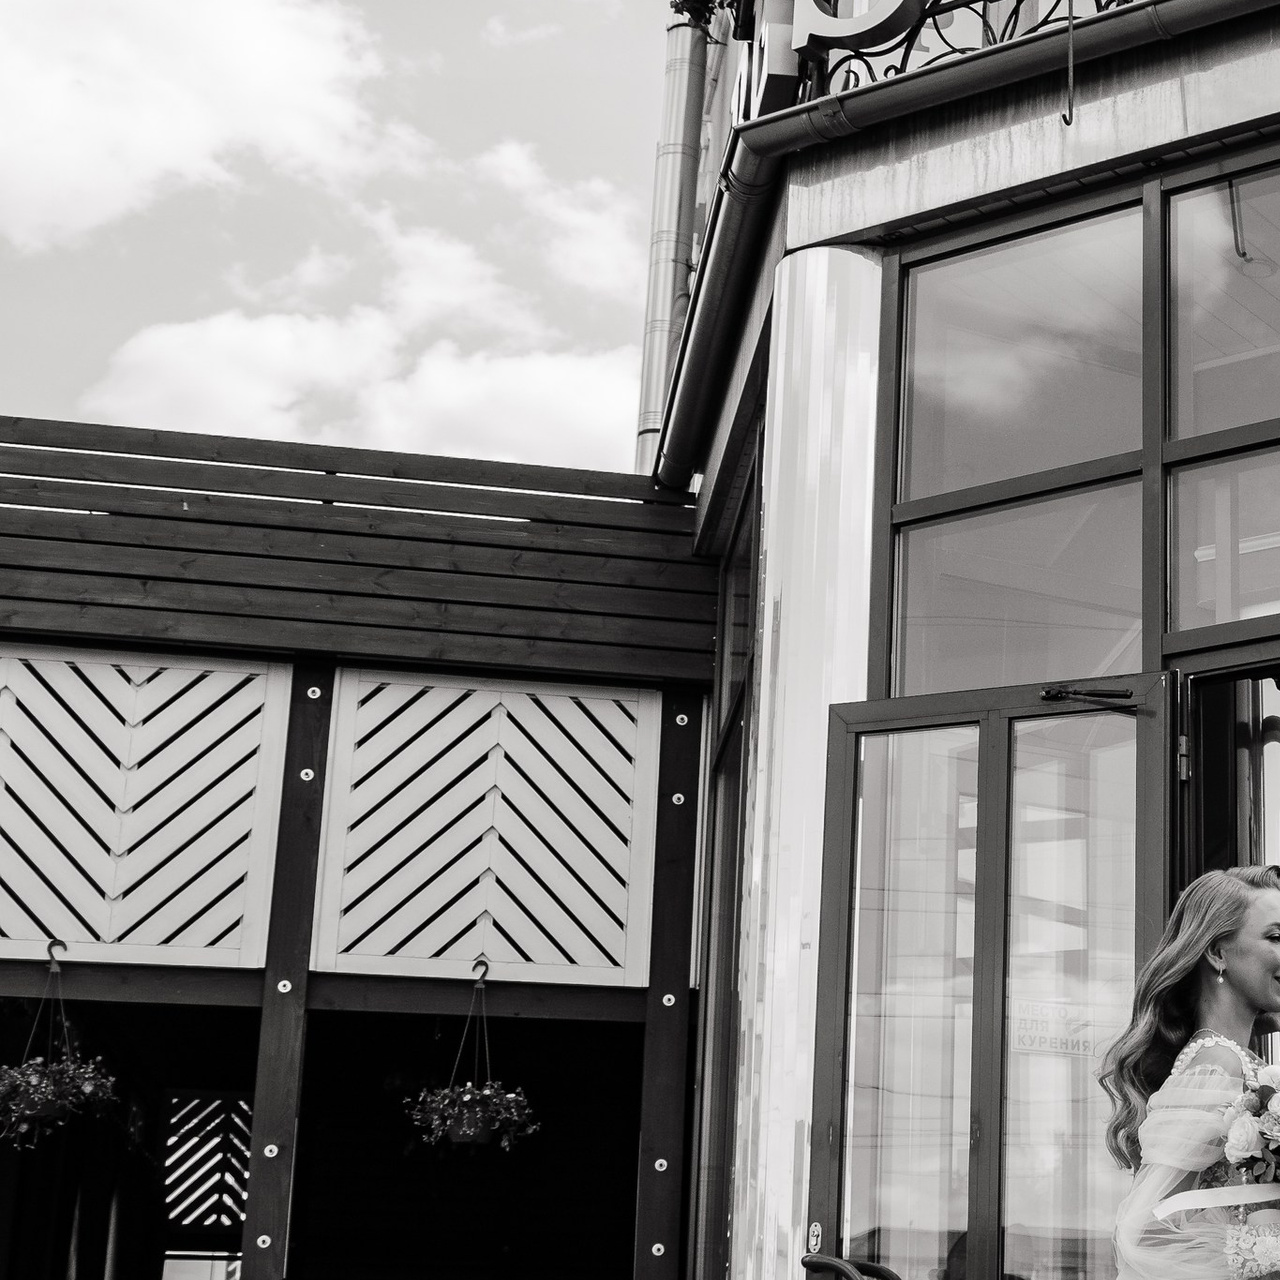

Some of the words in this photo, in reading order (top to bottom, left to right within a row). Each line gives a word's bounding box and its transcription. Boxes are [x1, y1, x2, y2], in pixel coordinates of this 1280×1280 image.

[1018, 1004, 1068, 1019] МЕСТО
[1017, 1018, 1049, 1033] ДЛЯ
[1018, 1034, 1091, 1052] КУРЕНИЯ
